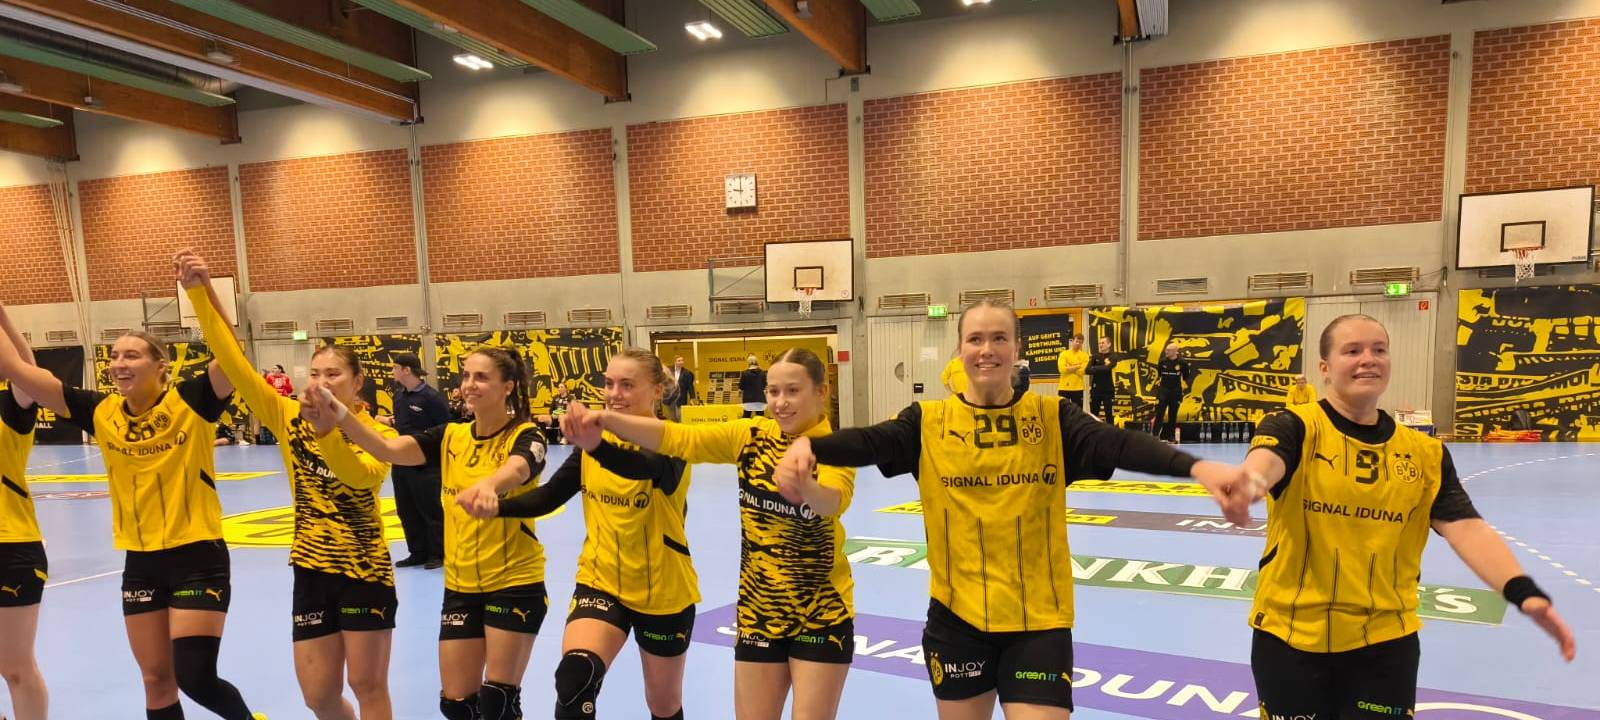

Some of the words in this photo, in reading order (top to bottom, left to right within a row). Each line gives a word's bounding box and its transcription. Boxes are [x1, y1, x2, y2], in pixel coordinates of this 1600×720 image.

[974, 414, 1018, 448] 29
[1022, 424, 1042, 438] BVB
[138, 443, 172, 456] IDUNA
[1356, 450, 1379, 484] 9
[1396, 462, 1416, 477] BVB
[941, 476, 992, 488] SIGNAL
[997, 473, 1038, 486] IDUNA
[600, 494, 630, 507] IDUNA
[763, 500, 797, 516] IDUNA
[1303, 499, 1350, 517] SIGNAL
[1355, 507, 1403, 523] IDUNA
[579, 598, 614, 608] INJOY
[295, 611, 325, 622] INJOY
[944, 661, 986, 673] INJOY
[1048, 673, 1057, 681] IT
